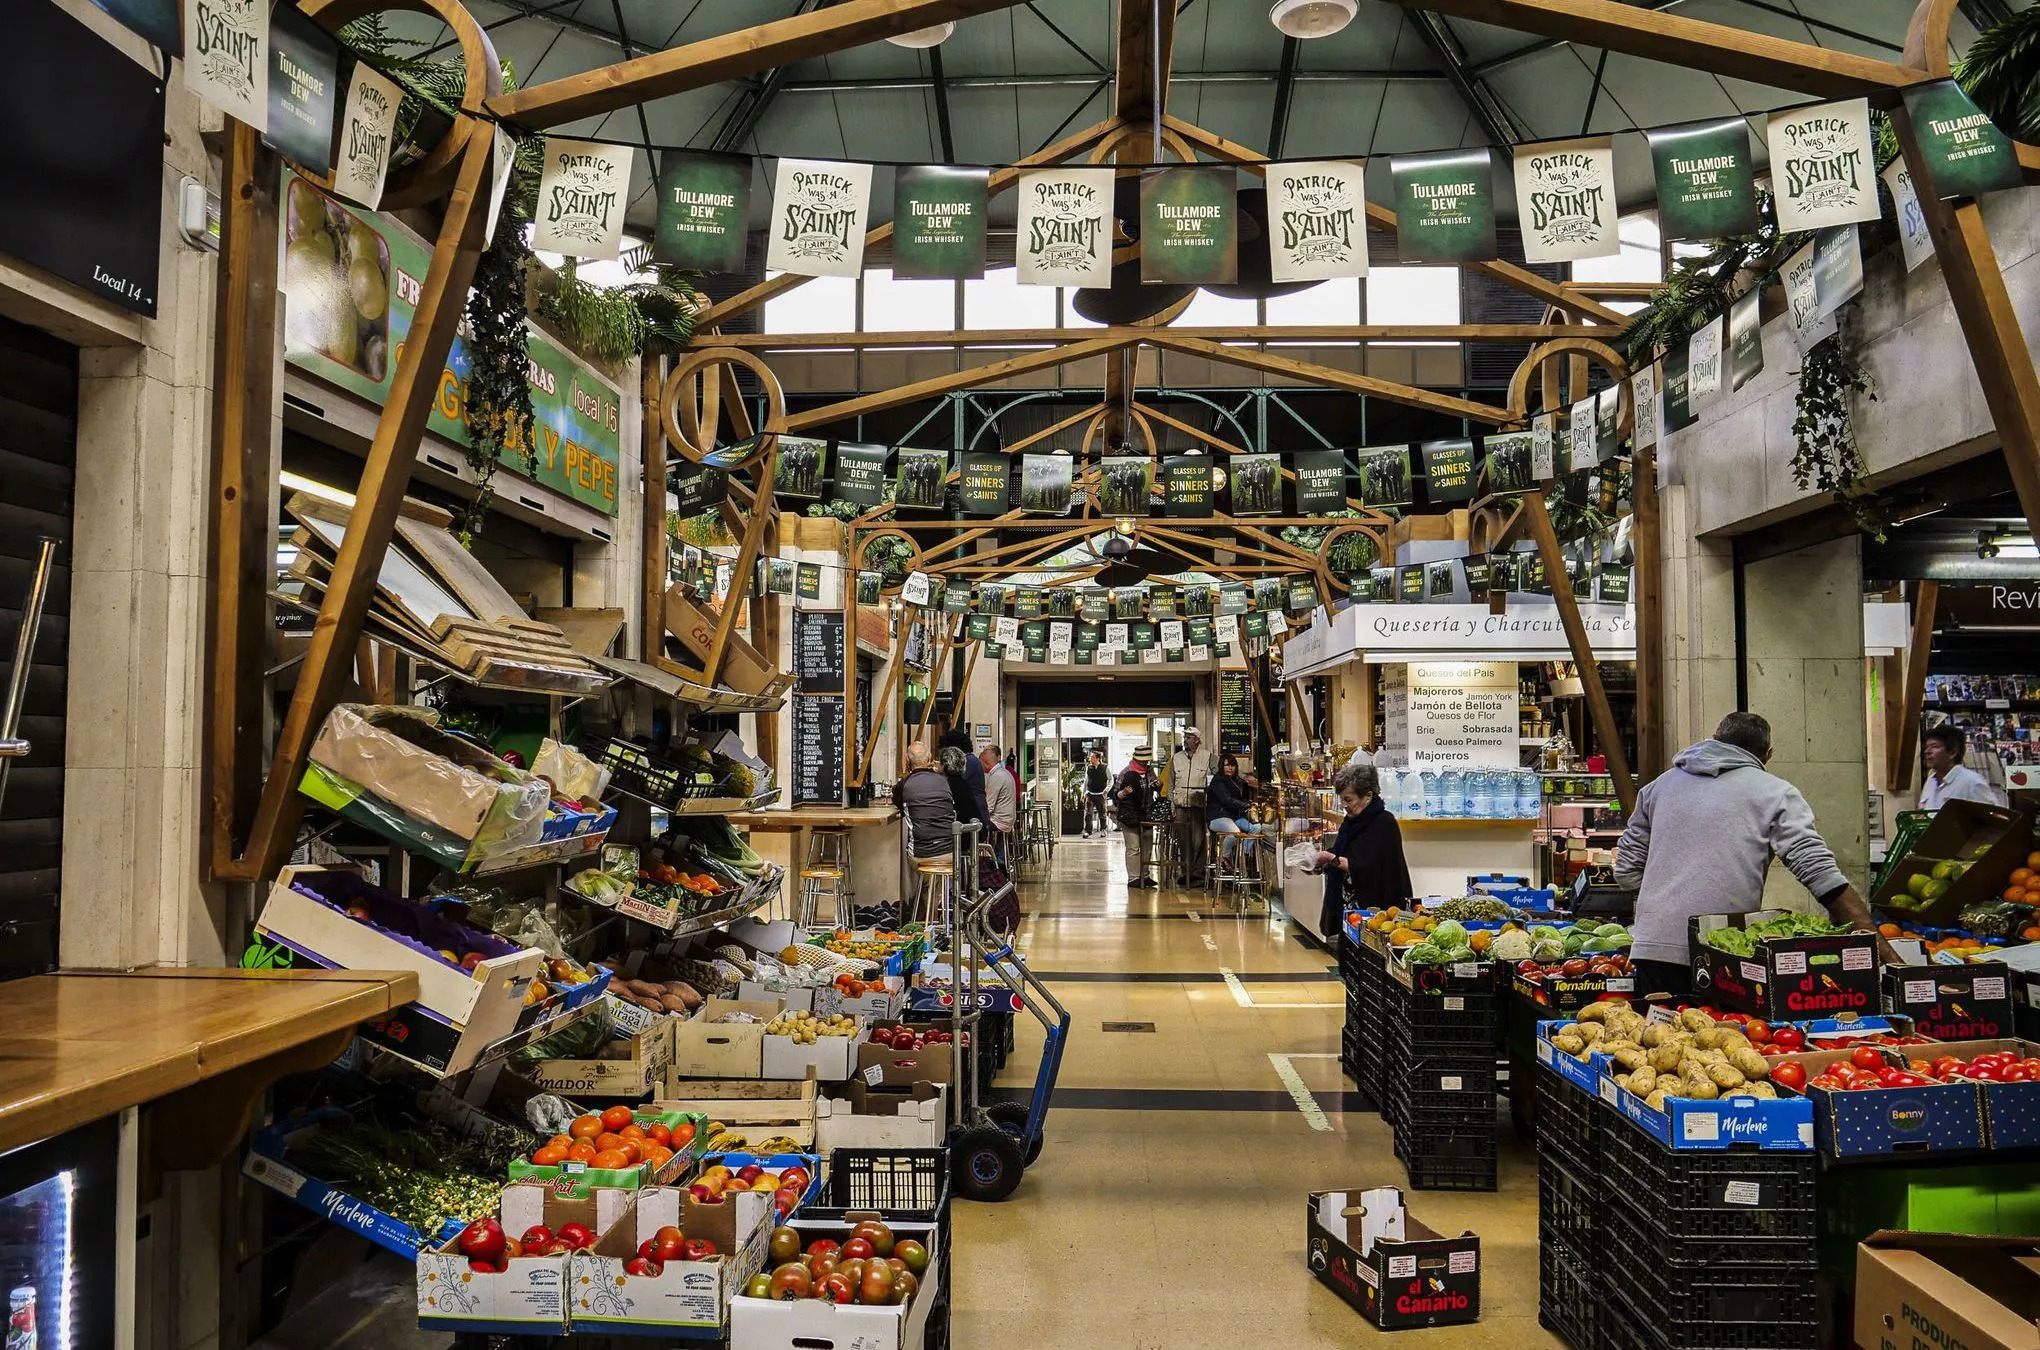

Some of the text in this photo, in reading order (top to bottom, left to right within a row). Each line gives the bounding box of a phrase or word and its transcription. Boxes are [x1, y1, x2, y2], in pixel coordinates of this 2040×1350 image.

[279, 51, 324, 96] TULLAMORE
[291, 81, 310, 104] DEW
[358, 82, 389, 115] PATRICK
[1785, 118, 1850, 145] PATRICK
[1954, 128, 1980, 144] DEW
[1803, 134, 1836, 150] WAS A
[1948, 145, 1996, 161] IRISH WHISKEY
[559, 154, 614, 176] PATRICK
[1530, 154, 1594, 179] PATRICK
[1670, 156, 1736, 174] TULLAMORE
[572, 170, 588, 184] WAS
[1549, 170, 1580, 185] WAS A
[1692, 172, 1719, 186] DEW
[1785, 149, 1862, 198] SAINT
[793, 172, 852, 194] PATRICK
[1283, 176, 1345, 198] PATRICK
[1410, 182, 1476, 198] TULLAMORE
[674, 188, 734, 208] TULLAMORE
[808, 188, 838, 202] WAS A
[1036, 182, 1096, 204] PATRICK
[1301, 192, 1332, 206] WAS A
[1682, 190, 1732, 202] IRISH WHISKEY
[910, 200, 971, 216] TULLAMORE
[1052, 198, 1082, 212] WAS A
[1432, 197, 1458, 210] DEW
[1530, 185, 1604, 231] SAINT
[691, 206, 714, 218] DEW
[1157, 204, 1220, 219] TULLAMORE
[677, 223, 725, 234] IRISH WHISKEY
[783, 204, 856, 250] SAINT
[928, 216, 953, 228] DEW
[1176, 218, 1202, 231] DEW
[1420, 216, 1472, 226] IRISH WHISKEY
[1281, 208, 1354, 250] SAINT
[914, 235, 964, 244] IRISH WHISKEY
[1029, 216, 1102, 259] SAINT
[1820, 228, 1850, 259] TULLAMORE
[93, 264, 142, 300] Local 14
[574, 378, 600, 423] local
[604, 400, 618, 434] 15
[544, 424, 616, 501] Y PEPE
[1432, 450, 1456, 460] GLASSES
[840, 456, 882, 472] TULLAMORE
[970, 464, 992, 472] GLASSES
[1431, 462, 1471, 476] SINNERS
[851, 469, 868, 479] DEW
[1298, 468, 1342, 480] TULLAMORE
[1441, 476, 1466, 487] SAINTS
[966, 478, 1004, 489] SINNERS
[1170, 480, 1208, 492] SINNERS
[1312, 478, 1330, 488] DEW
[973, 490, 998, 500] SAINTS
[1178, 494, 1203, 503] SAINTS
[1992, 586, 2040, 610] Revi
[1374, 614, 1602, 638] Quesería y Charcutía
[1418, 668, 1472, 678] Quesos del
[1414, 688, 1464, 697] Majoreros
[1410, 701, 1502, 710] Jamón de Bellota
[1426, 711, 1496, 720] Quesos de Flor
[1416, 726, 1435, 734] Brie
[1462, 724, 1513, 734] Sobrasada
[1435, 738, 1502, 746] Queso Palmero
[1415, 750, 1470, 762] Majoreros
[1554, 980, 1606, 992] Tornafruit
[1787, 988, 1868, 1011] Canario
[622, 1000, 642, 1019] Huerta
[1916, 1018, 2000, 1039] Canario
[1892, 1110, 1924, 1120] Bonny
[1722, 1116, 1768, 1139] Marlene
[320, 1190, 375, 1228] Marlene
[1396, 1290, 1468, 1314] Canario
